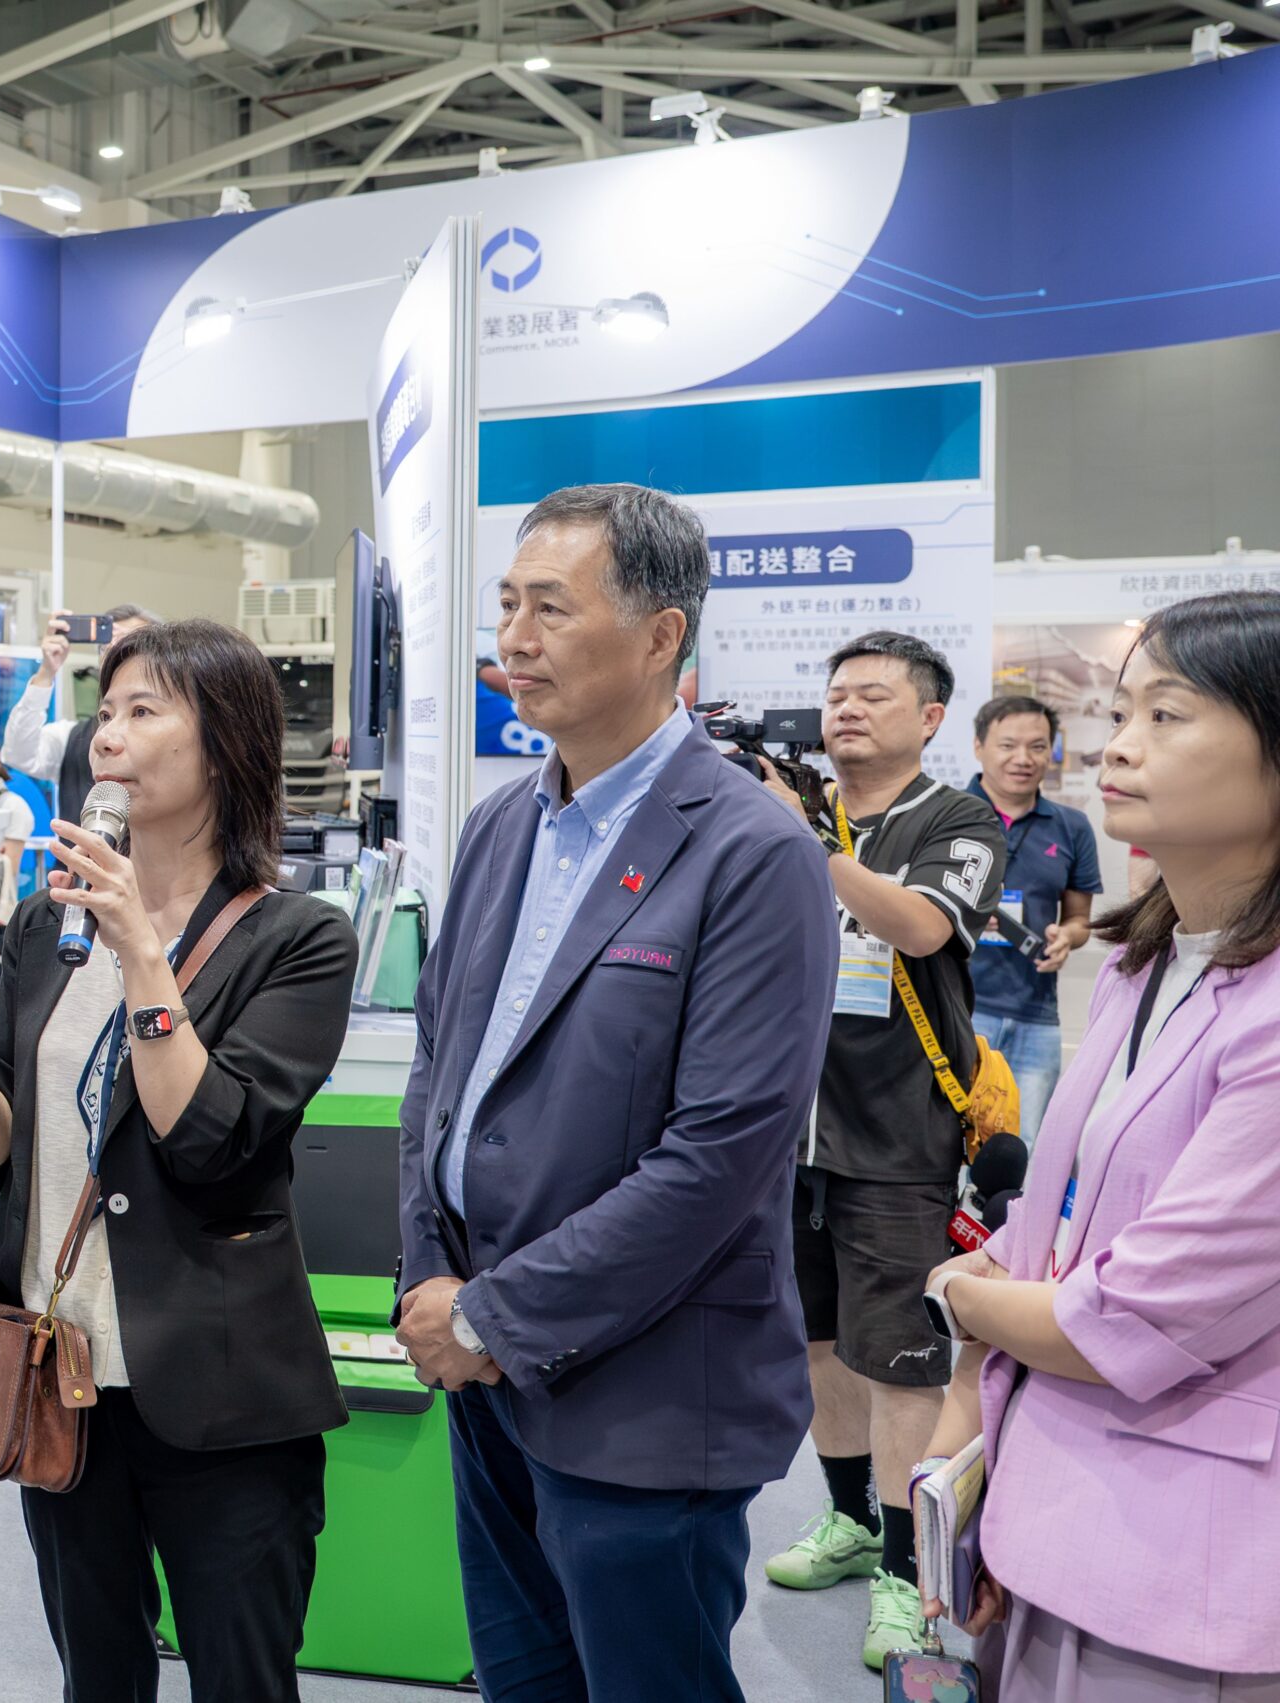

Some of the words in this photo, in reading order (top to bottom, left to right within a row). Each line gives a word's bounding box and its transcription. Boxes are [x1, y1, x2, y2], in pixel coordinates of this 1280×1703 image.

[544, 335, 580, 348] MOEA
[779, 719, 797, 729] 4K
[942, 838, 994, 910] 3
[609, 948, 672, 966] TAOYUAN
[903, 990, 917, 1006] THE
[912, 1008, 928, 1029] PAST
[923, 1032, 936, 1049] THE
